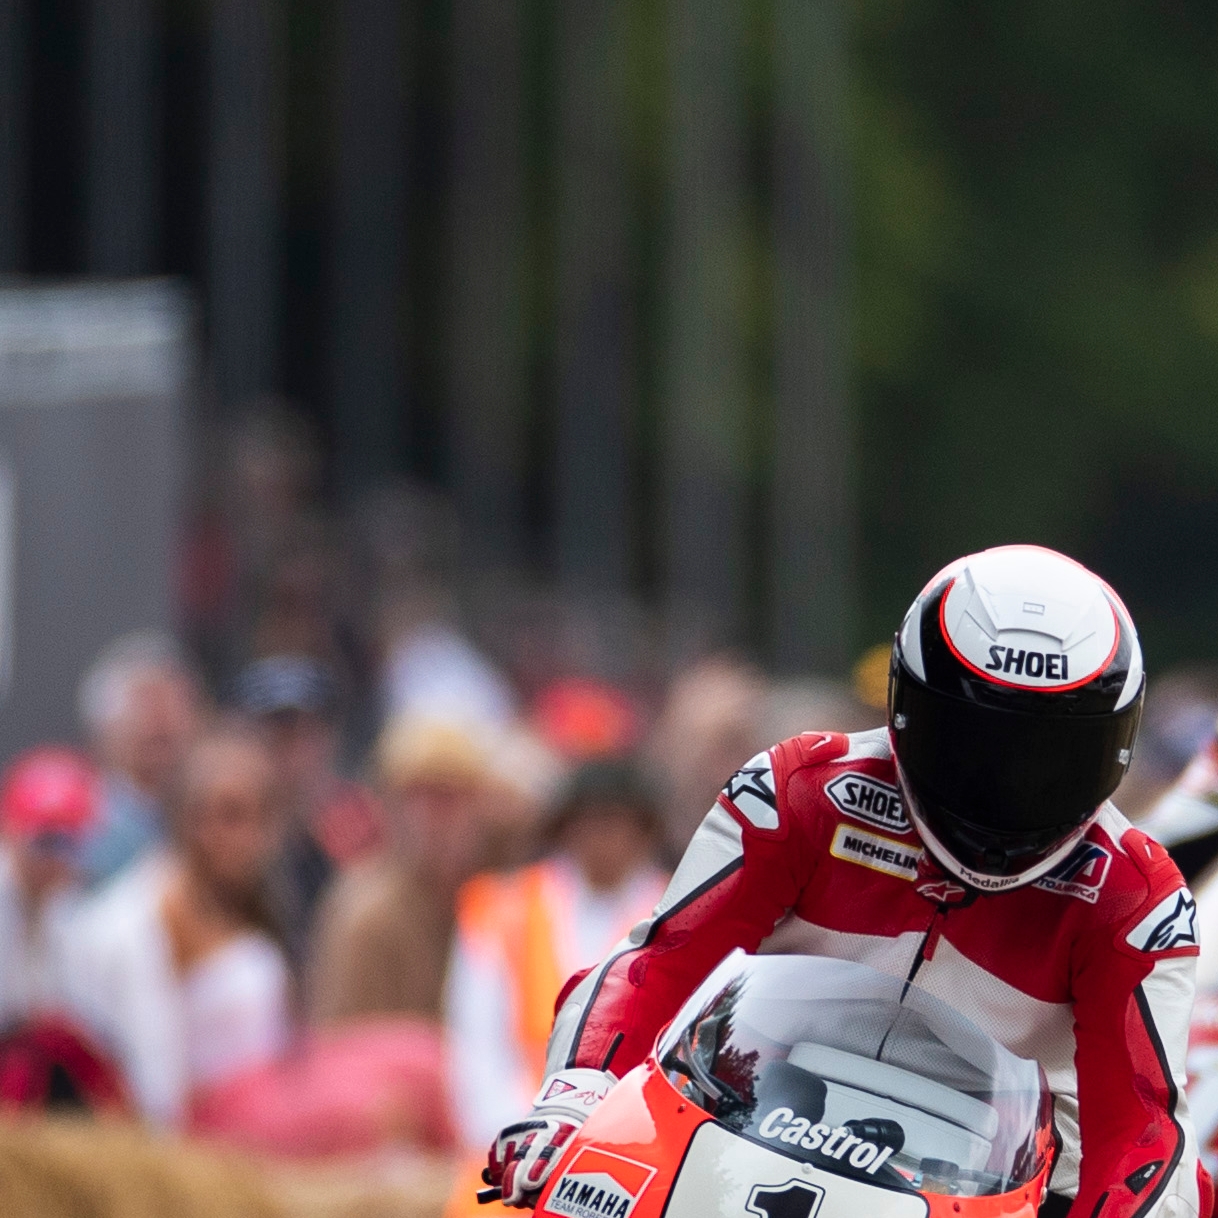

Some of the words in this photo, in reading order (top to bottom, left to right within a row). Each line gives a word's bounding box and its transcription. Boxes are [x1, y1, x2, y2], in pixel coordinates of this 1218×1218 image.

[985, 645, 1069, 680] SHOEI
[843, 836, 918, 871] MICHELIN
[758, 1107, 894, 1175] Castrol
[550, 1199, 575, 1213] TEAM
